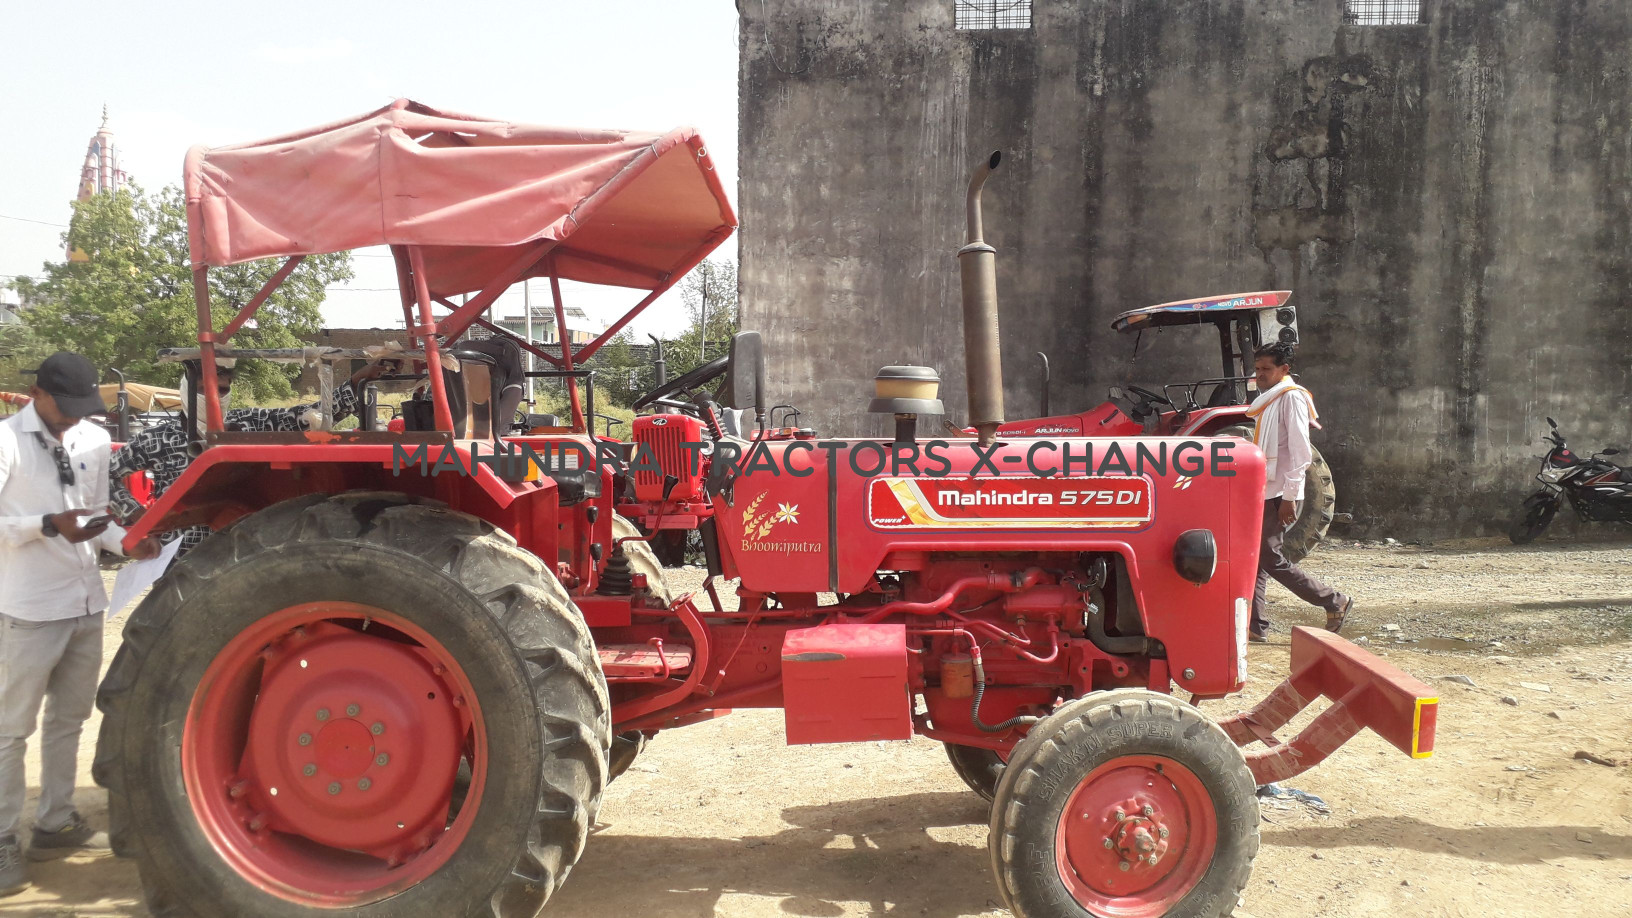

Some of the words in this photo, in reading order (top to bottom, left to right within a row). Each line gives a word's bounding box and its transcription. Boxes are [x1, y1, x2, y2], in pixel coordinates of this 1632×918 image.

[1233, 297, 1263, 307] ARJUN
[938, 490, 1053, 506] Mahindra
[741, 539, 821, 557] Bhoomiputra
[1107, 721, 1172, 740] SUPER
